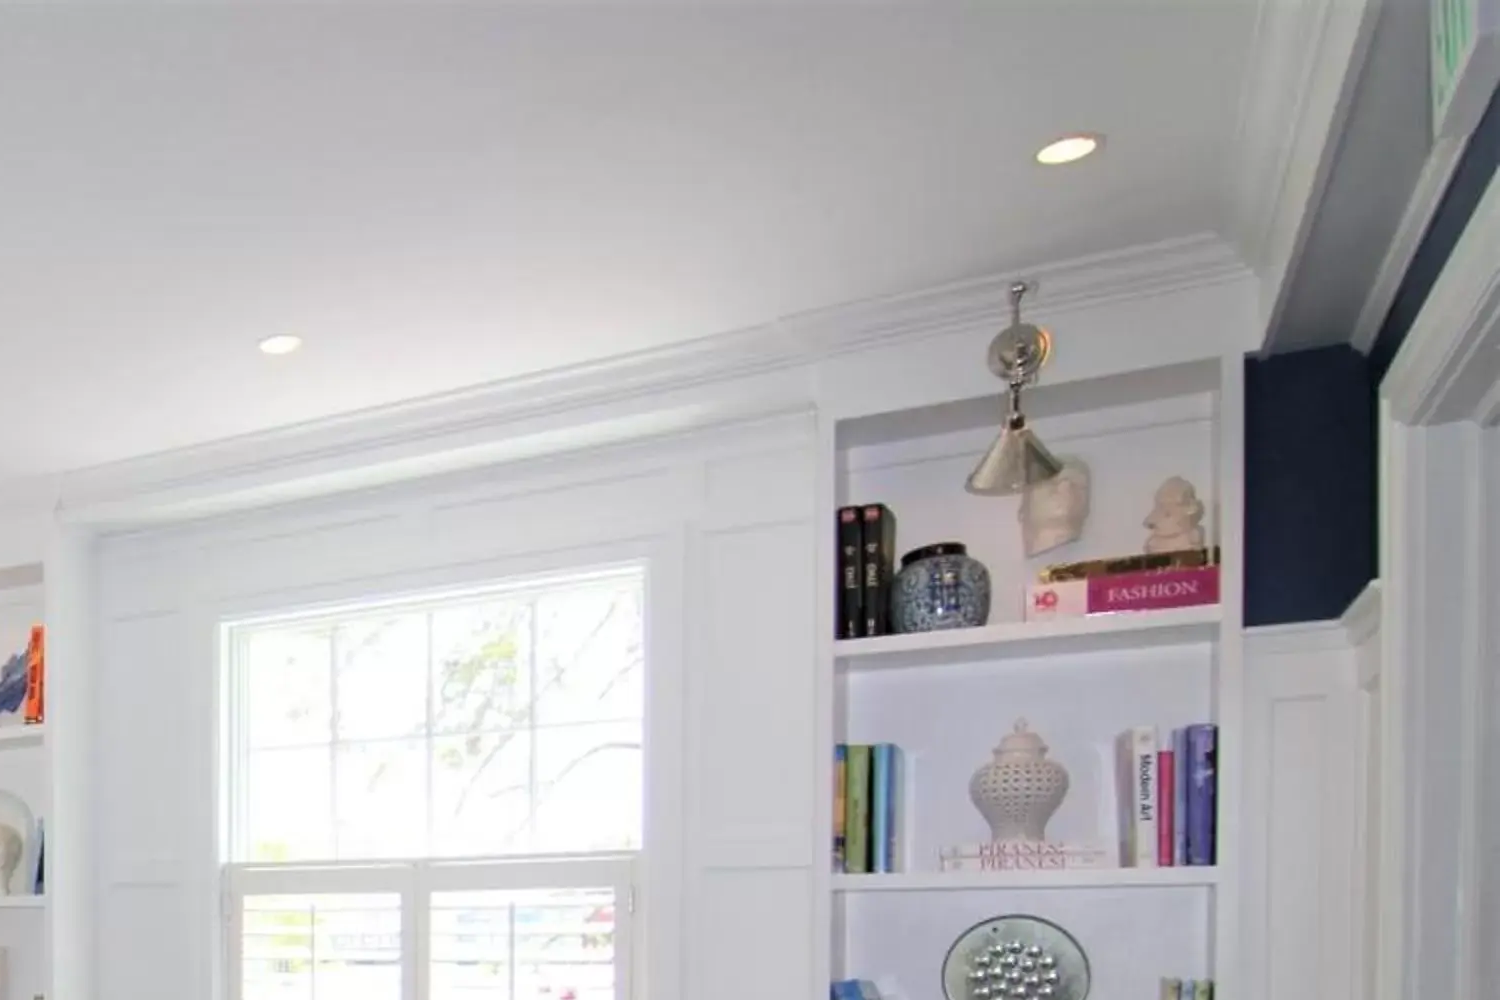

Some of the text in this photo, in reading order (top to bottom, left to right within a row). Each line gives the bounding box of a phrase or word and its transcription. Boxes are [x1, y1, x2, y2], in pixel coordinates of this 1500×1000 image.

[1107, 579, 1200, 603] FASHION
[1139, 754, 1153, 822] Modern Art
